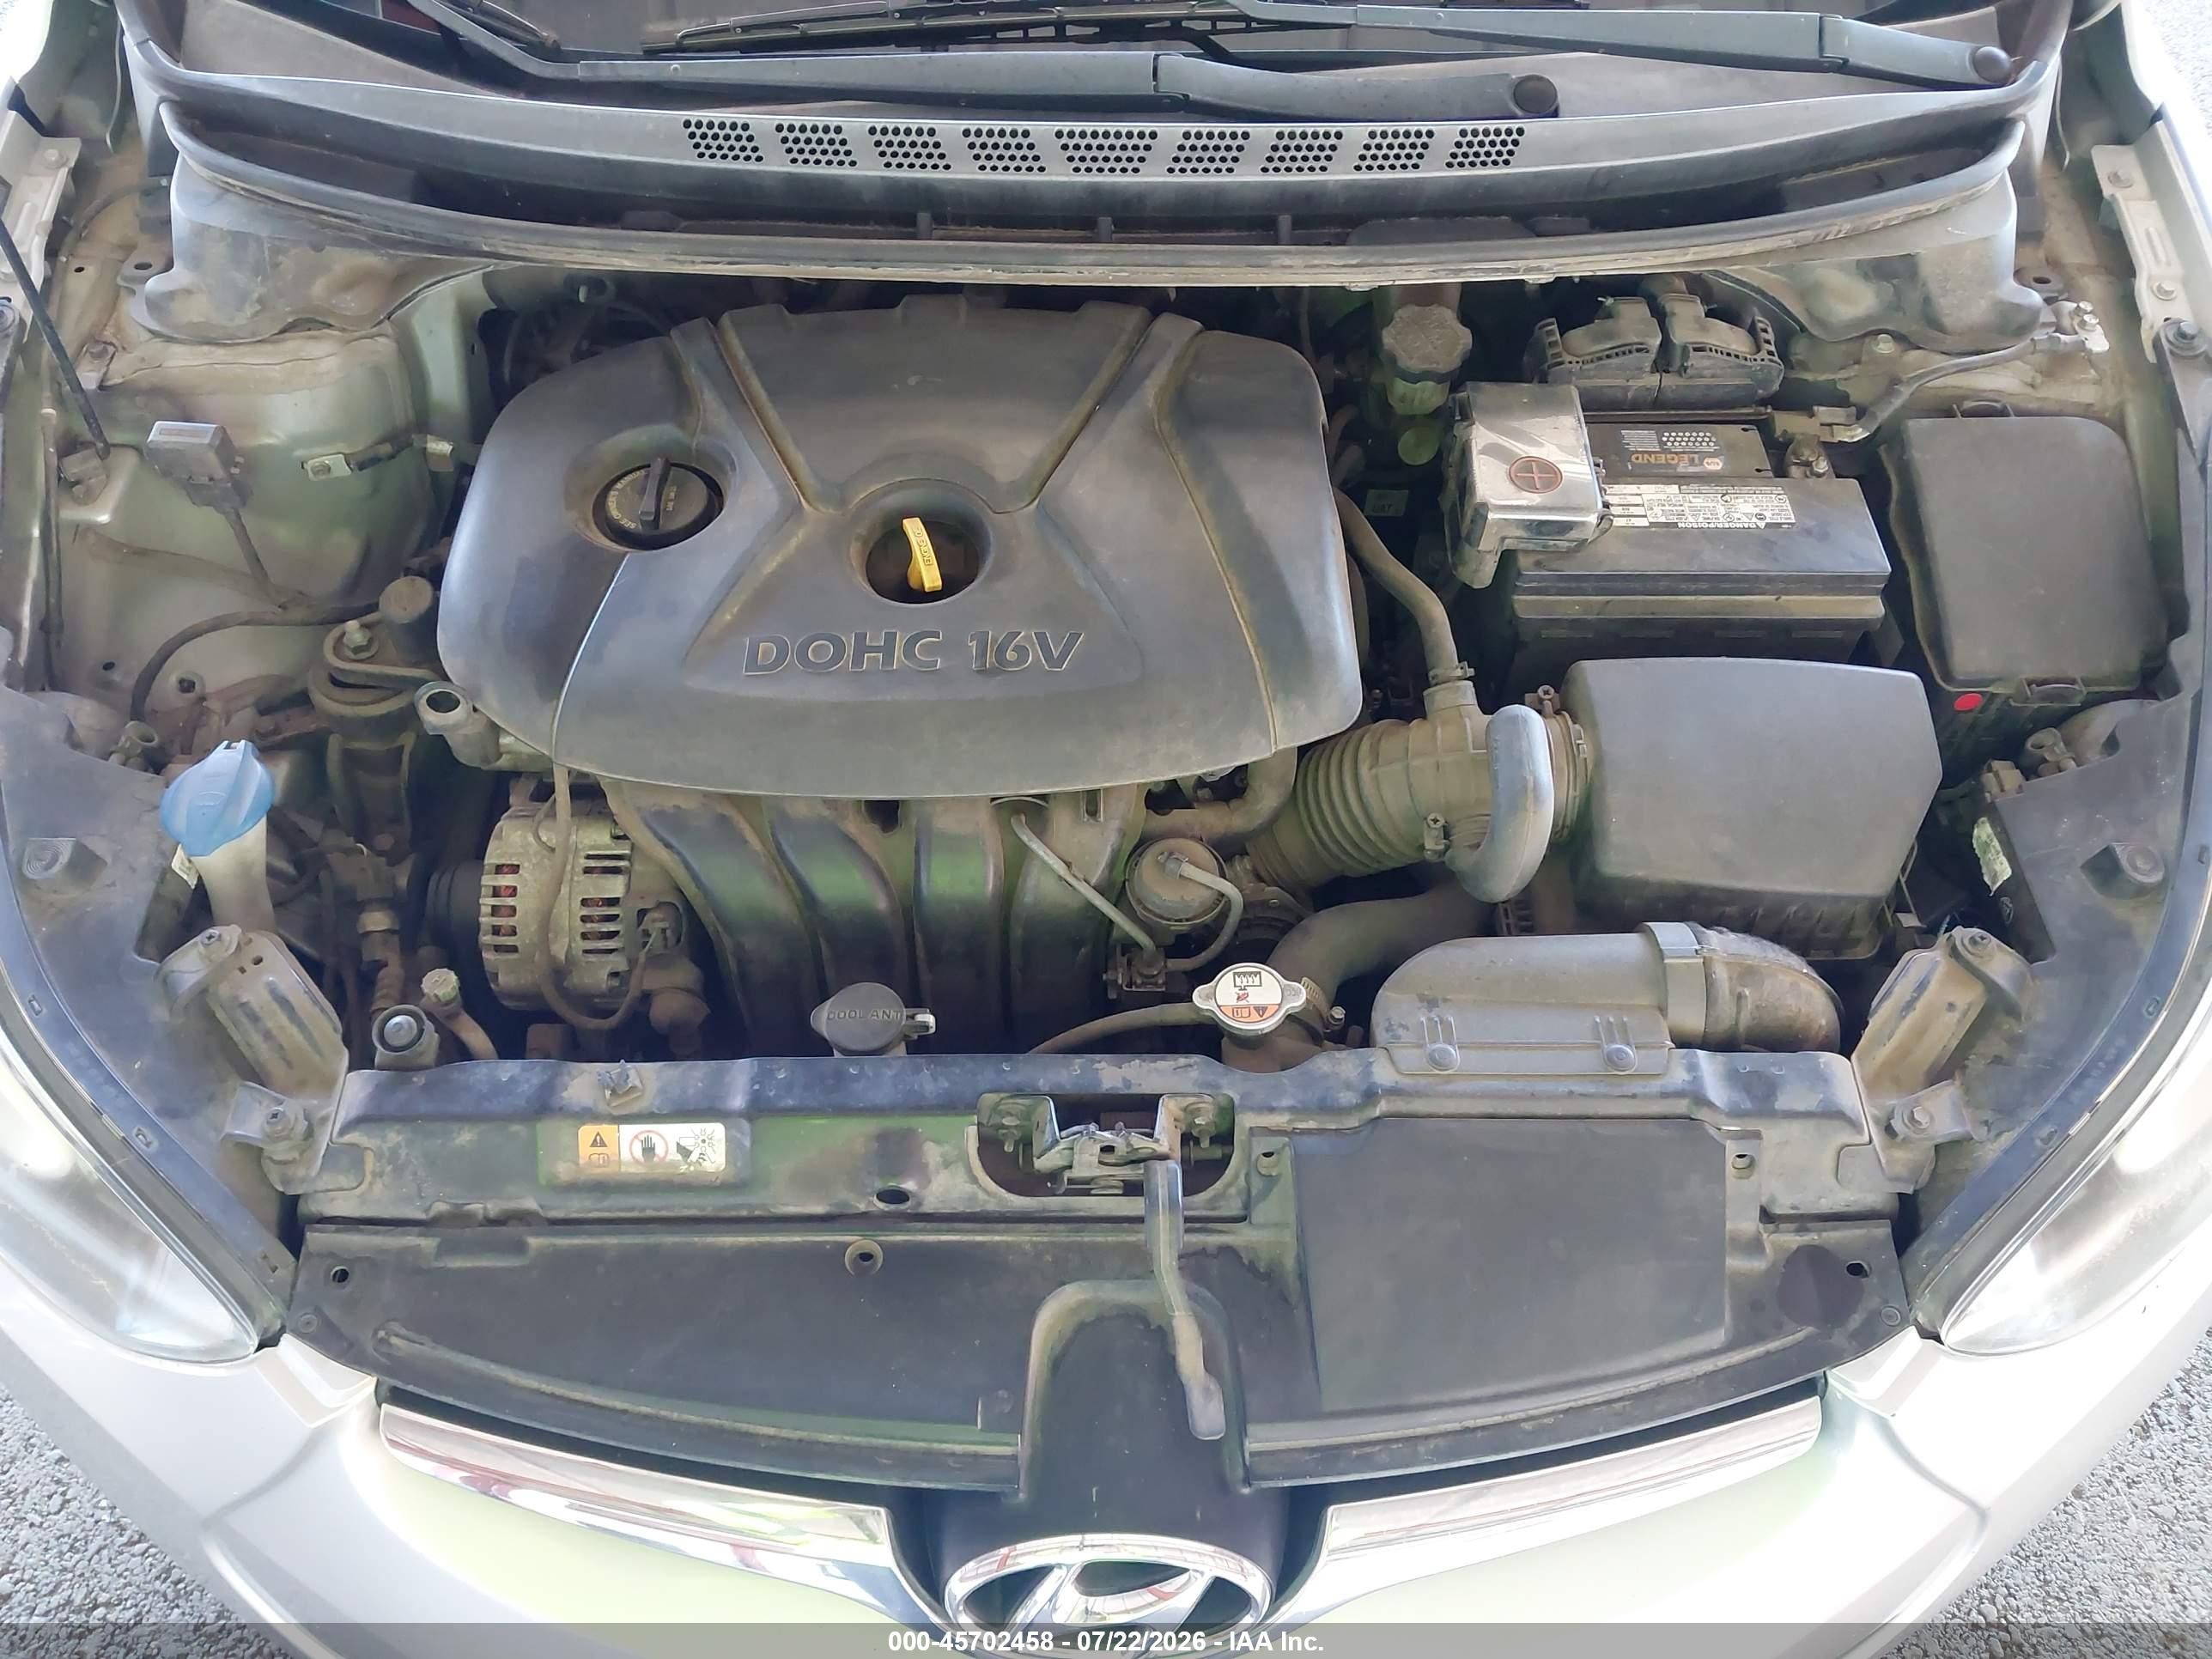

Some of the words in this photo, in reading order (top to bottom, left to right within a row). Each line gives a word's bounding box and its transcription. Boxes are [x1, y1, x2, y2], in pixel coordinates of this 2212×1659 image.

[1632, 453, 1700, 465] LEGEND
[619, 519, 637, 529] SEE
[744, 629, 943, 675] DOHC
[968, 630, 1085, 672] 16V
[826, 1008, 902, 1021] COOLANT
